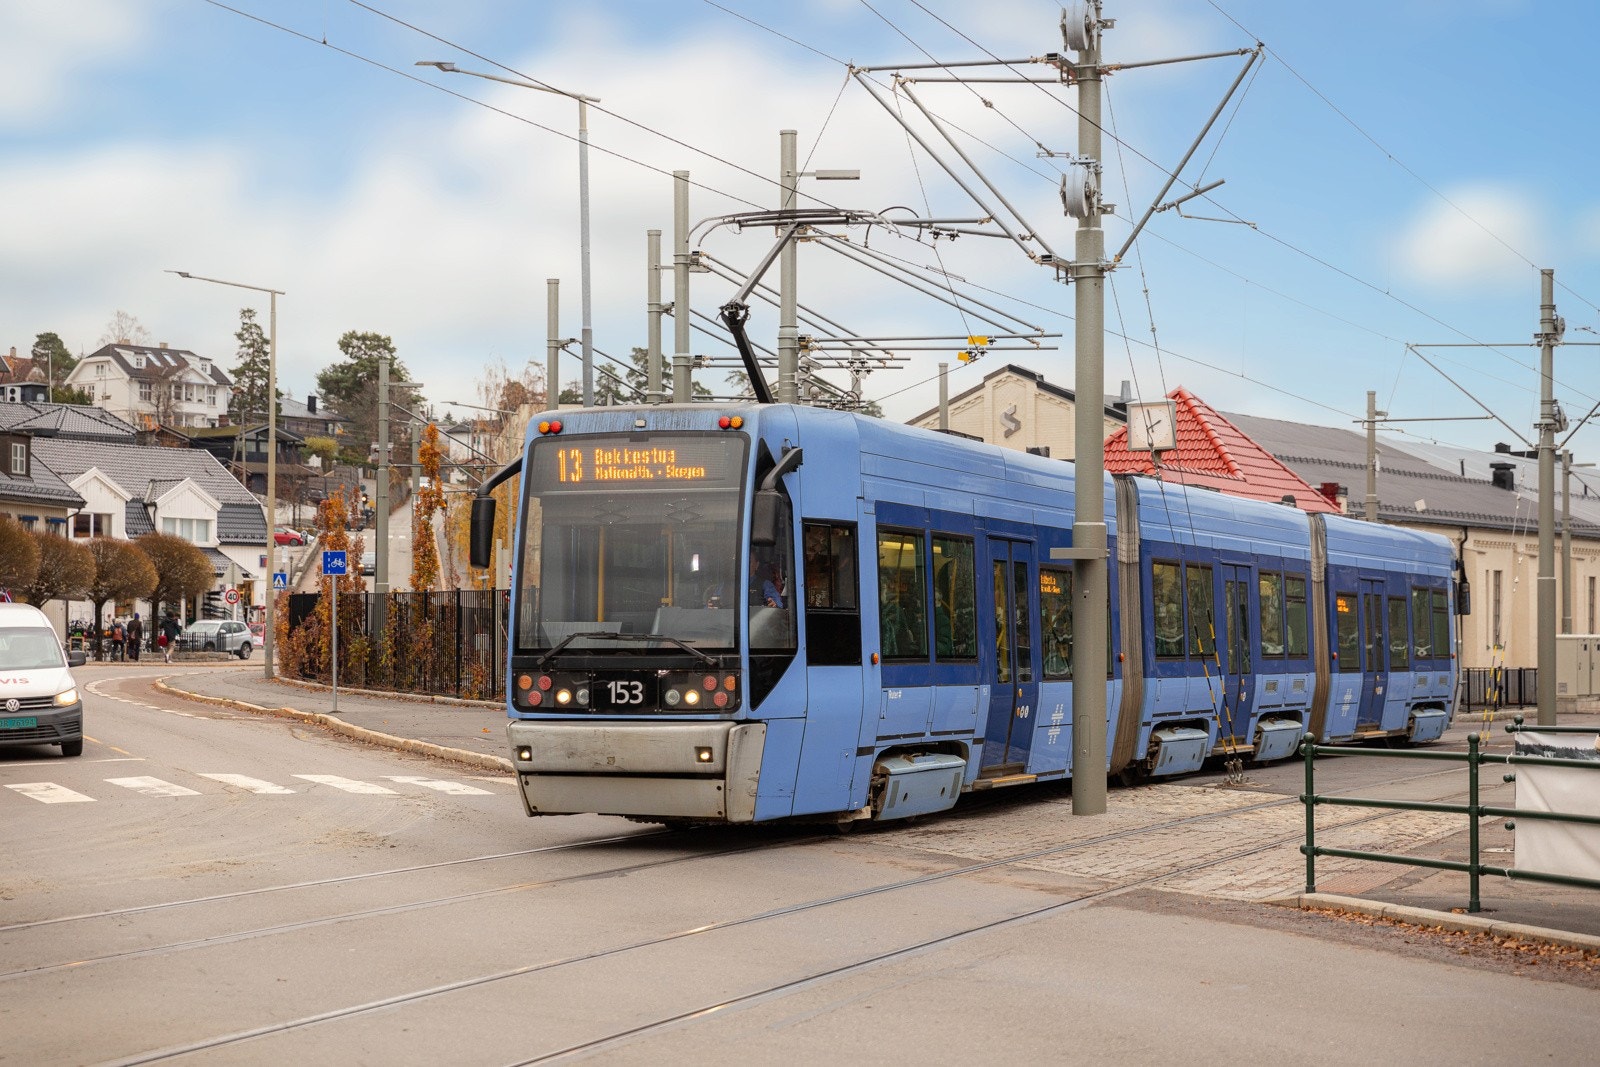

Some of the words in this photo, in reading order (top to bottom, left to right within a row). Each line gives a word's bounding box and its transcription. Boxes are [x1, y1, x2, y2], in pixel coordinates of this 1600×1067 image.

[558, 449, 582, 482] 13
[594, 448, 676, 464] Bekkestua
[607, 681, 643, 704] 153
